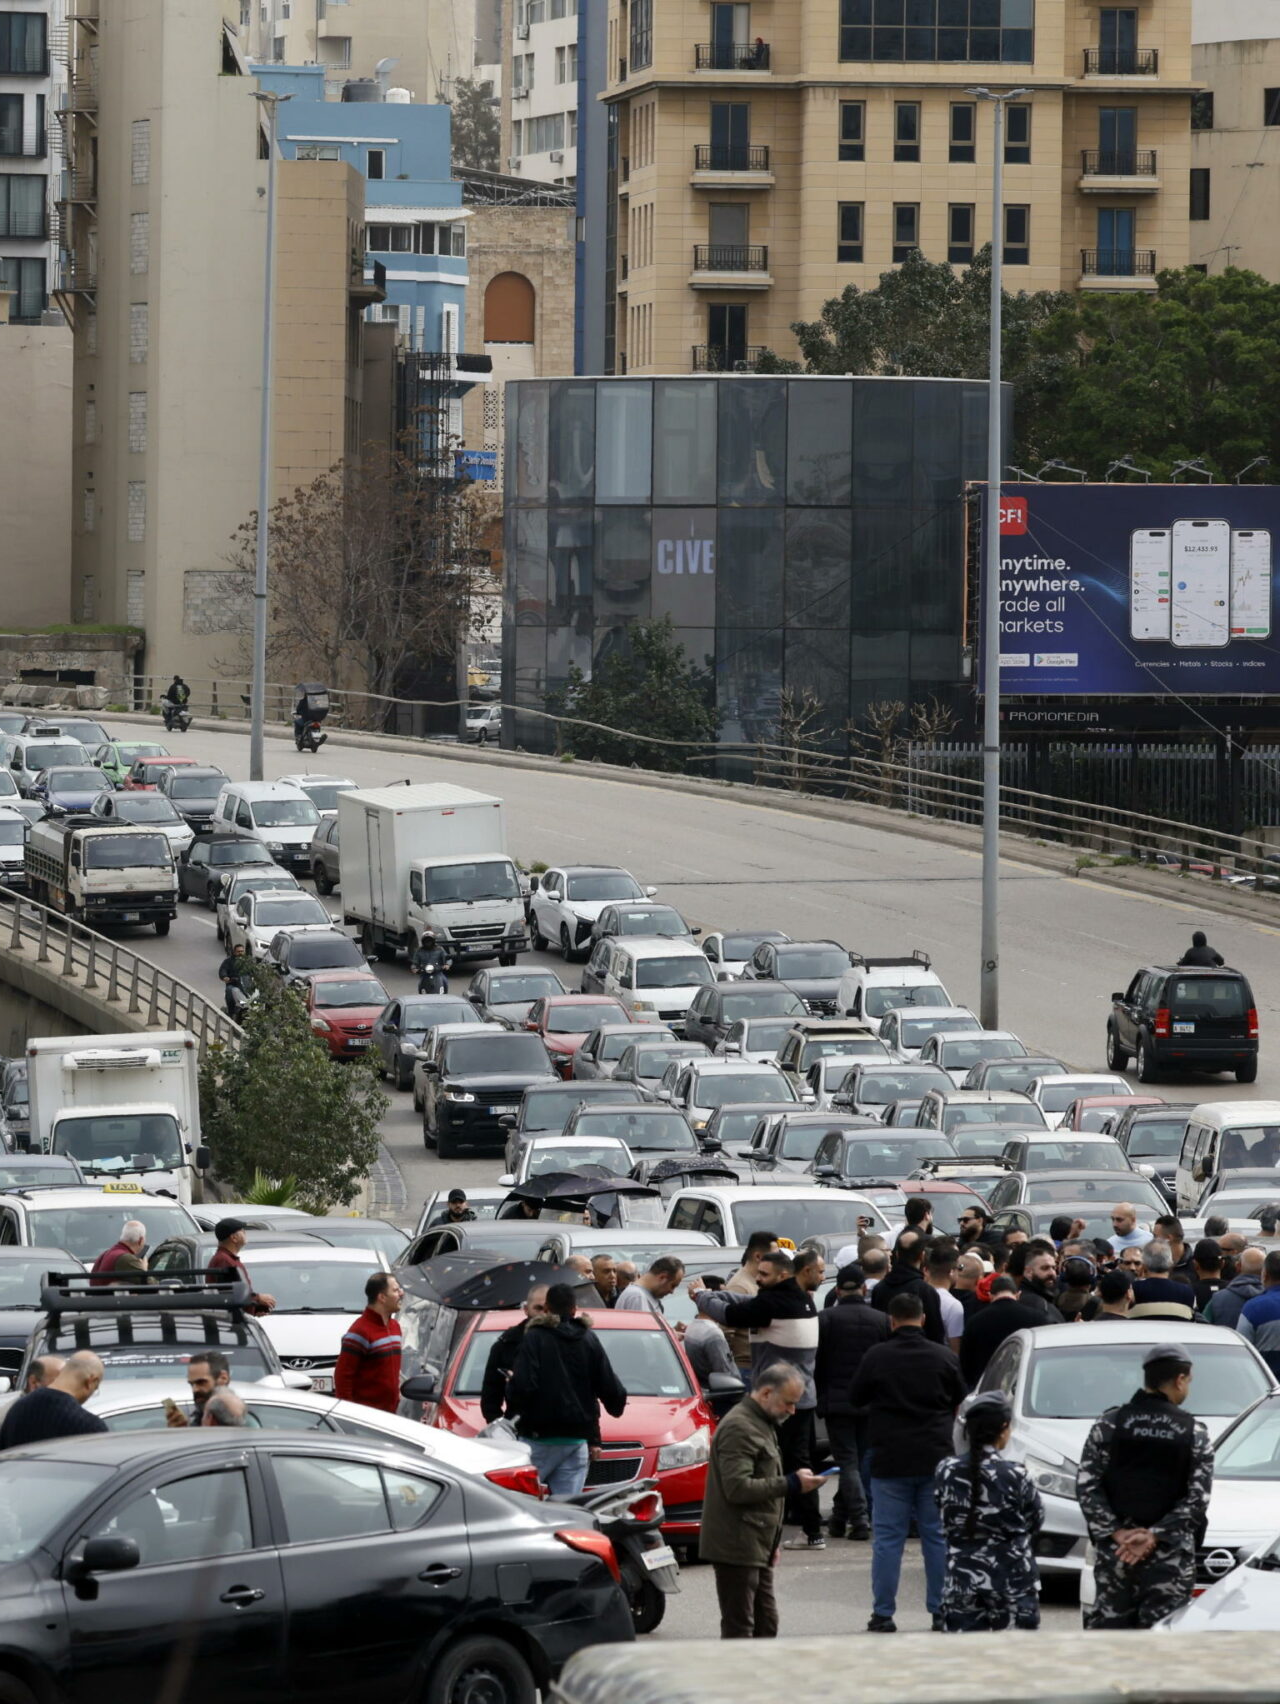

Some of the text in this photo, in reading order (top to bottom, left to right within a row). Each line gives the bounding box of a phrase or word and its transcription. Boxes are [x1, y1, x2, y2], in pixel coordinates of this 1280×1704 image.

[999, 554, 1071, 575] nytime.
[999, 576, 1086, 596] nywhere.
[999, 597, 1066, 612] rade all
[1134, 660, 1170, 668] Currencies
[1009, 711, 1099, 722] PROMOMEDIA
[110, 1183, 138, 1191] TAXI
[1134, 1428, 1175, 1440] POLICE
